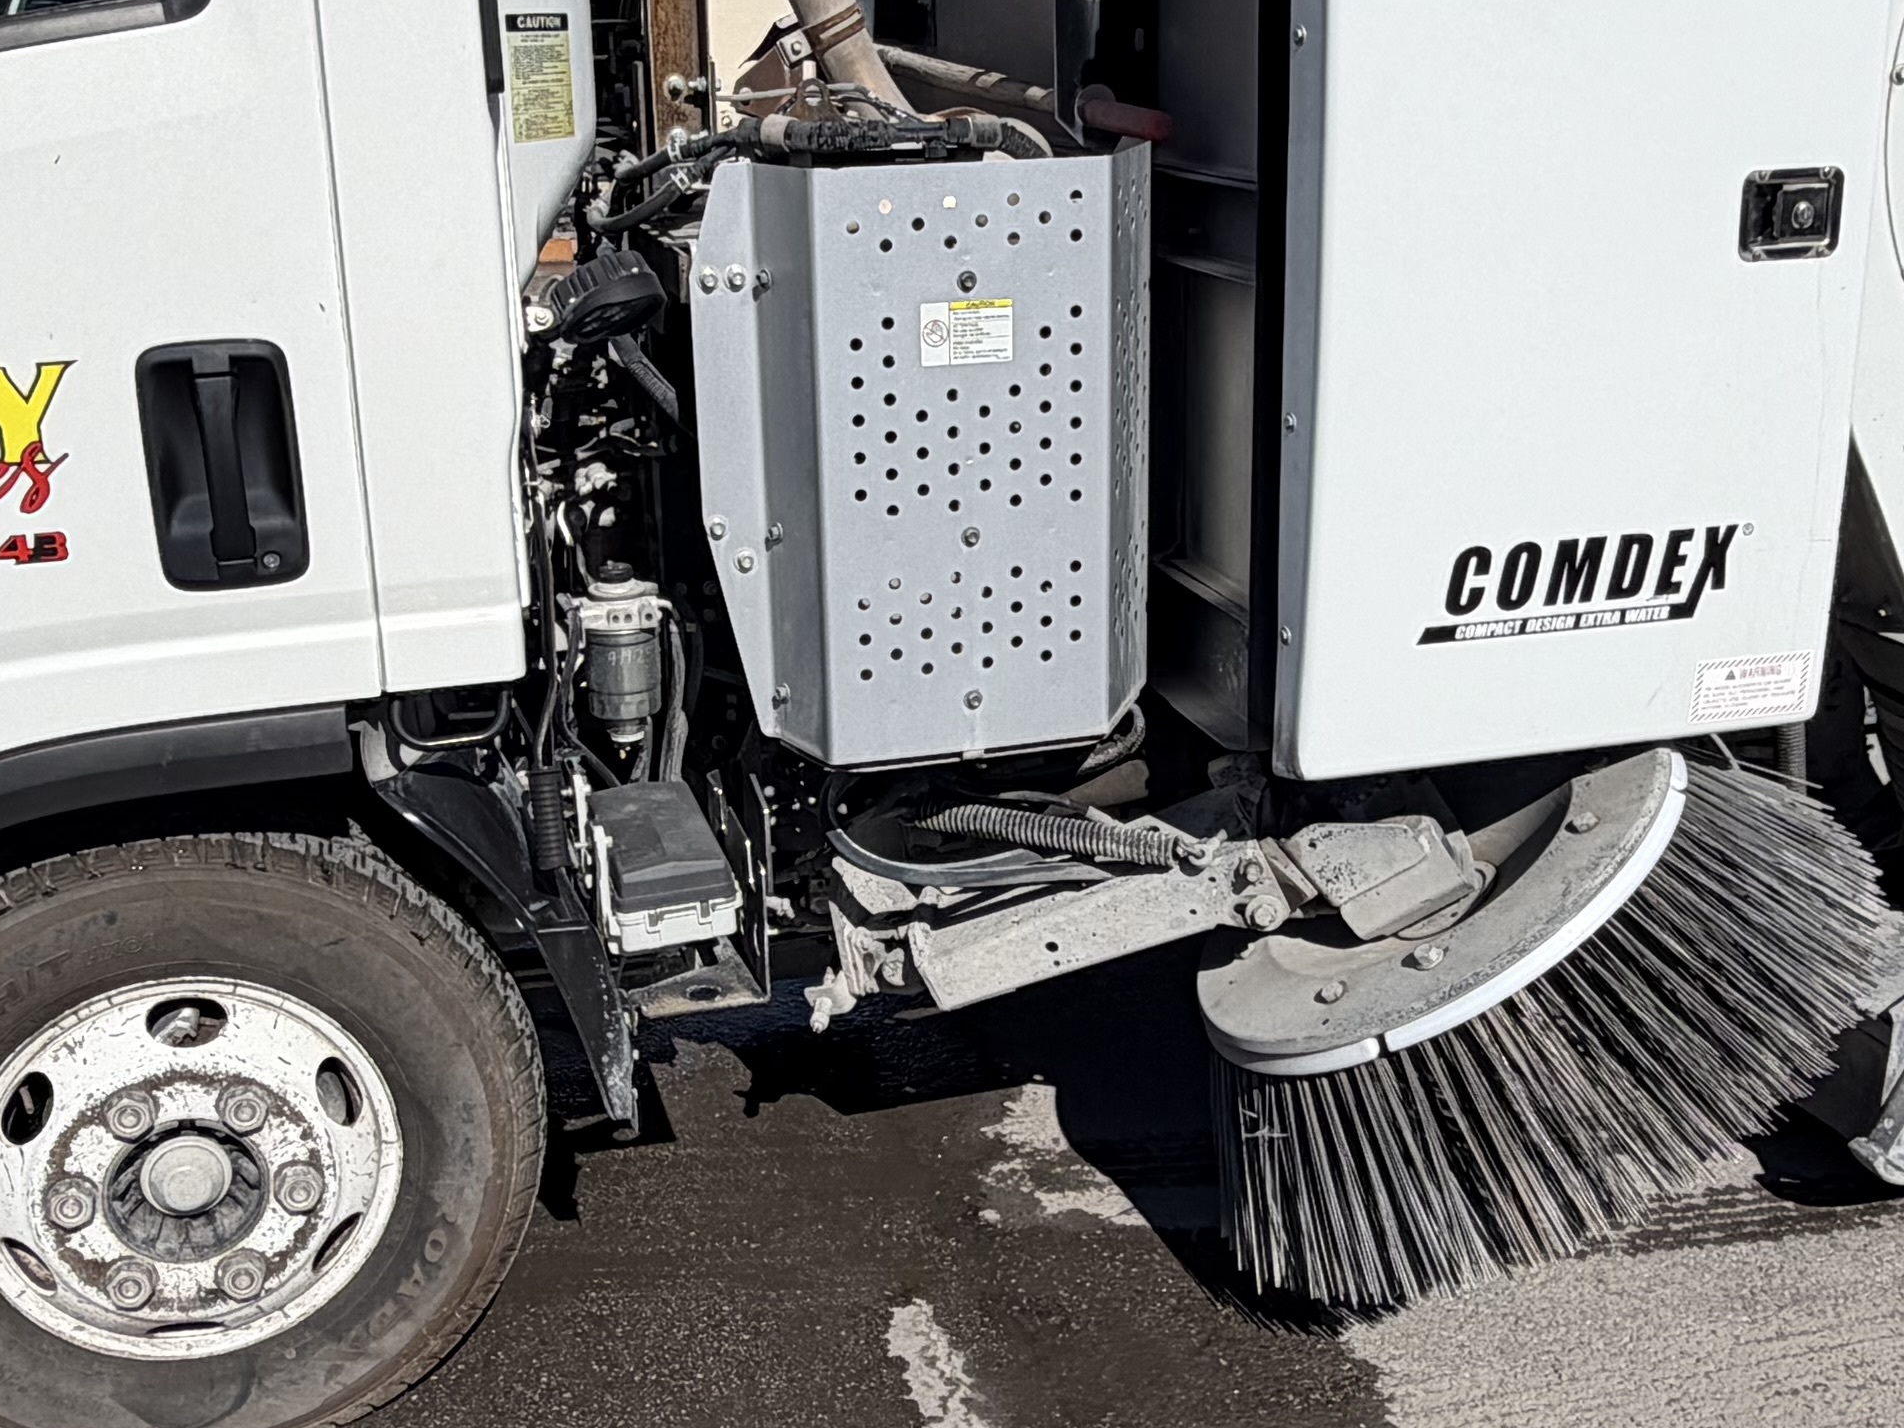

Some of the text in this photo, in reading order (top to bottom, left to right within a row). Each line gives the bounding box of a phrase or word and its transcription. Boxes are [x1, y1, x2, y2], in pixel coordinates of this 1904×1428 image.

[1444, 523, 1740, 617] COMDEX
[1454, 605, 1671, 640] COMPACT DESIGN EXTRA WATER
